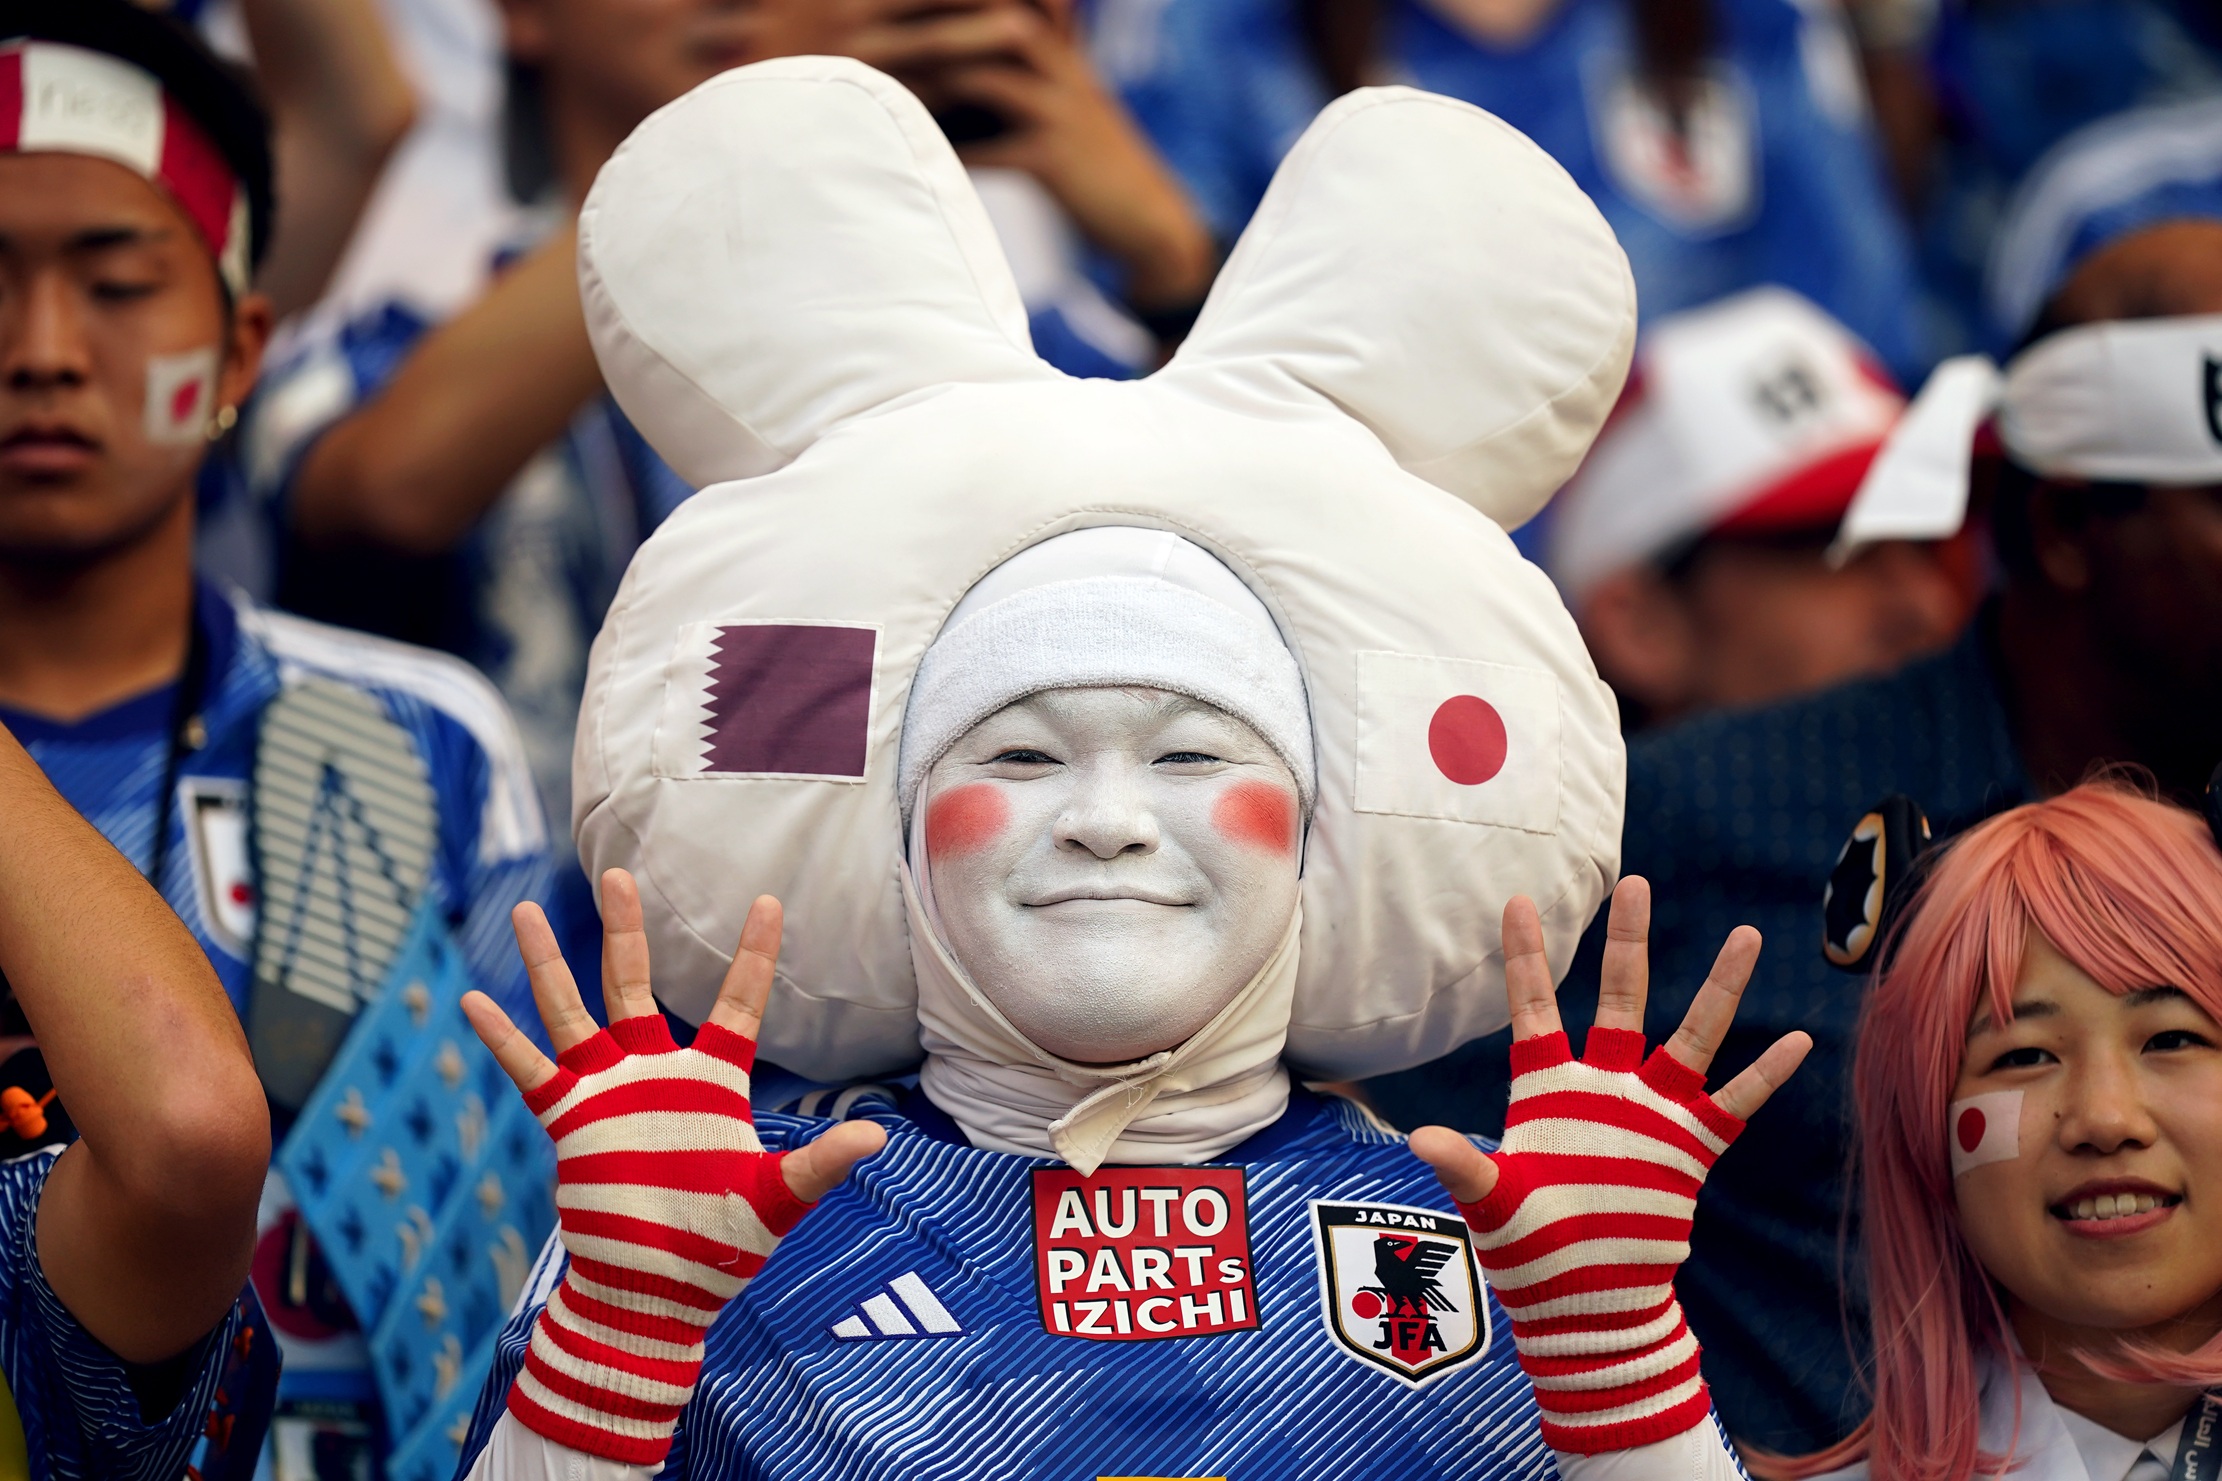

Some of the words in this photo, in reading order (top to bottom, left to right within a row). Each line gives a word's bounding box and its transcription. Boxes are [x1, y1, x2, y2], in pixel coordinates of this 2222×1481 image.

[1049, 1187, 1230, 1239] AUTO
[1355, 1211, 1437, 1230] JAPAN
[1052, 1288, 1247, 1335] IZICHI
[1373, 1321, 1447, 1351] JFA
